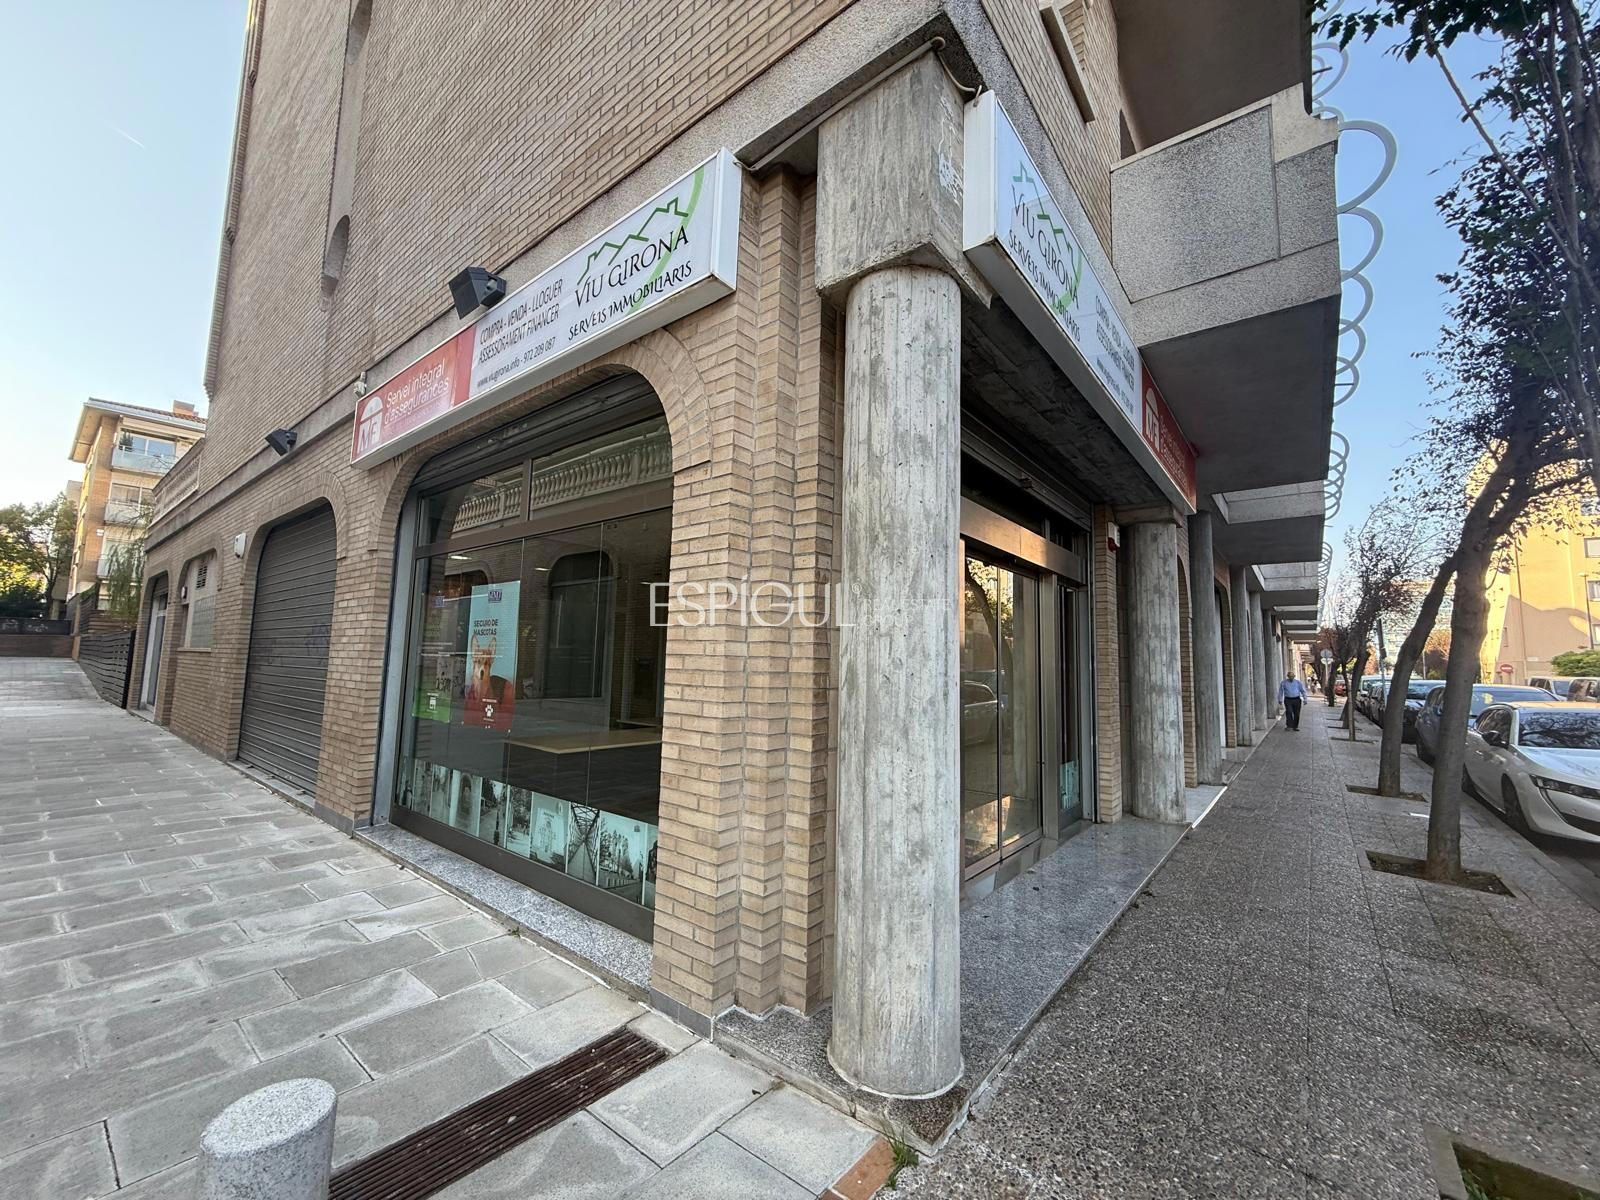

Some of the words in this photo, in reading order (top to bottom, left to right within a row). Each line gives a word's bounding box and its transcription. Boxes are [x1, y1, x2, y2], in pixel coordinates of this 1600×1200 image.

[575, 274, 604, 308] VIU
[608, 225, 689, 287] GIRONA
[1008, 229, 1039, 283] SERVEIS
[1039, 271, 1081, 342] IMMOBILIARIS
[1012, 184, 1035, 239] VIU
[1038, 229, 1080, 310] GIRONA
[479, 323, 526, 364] ASSESSORAMENT
[527, 303, 560, 337] FINANCER
[480, 319, 503, 345] COMPRA
[507, 303, 528, 328] VENDA
[532, 278, 563, 312] LLOGUER
[568, 307, 607, 340] SERVEIS
[608, 260, 692, 316] IMMOBILIARIS
[386, 385, 411, 408] Servei
[411, 357, 446, 393] integral
